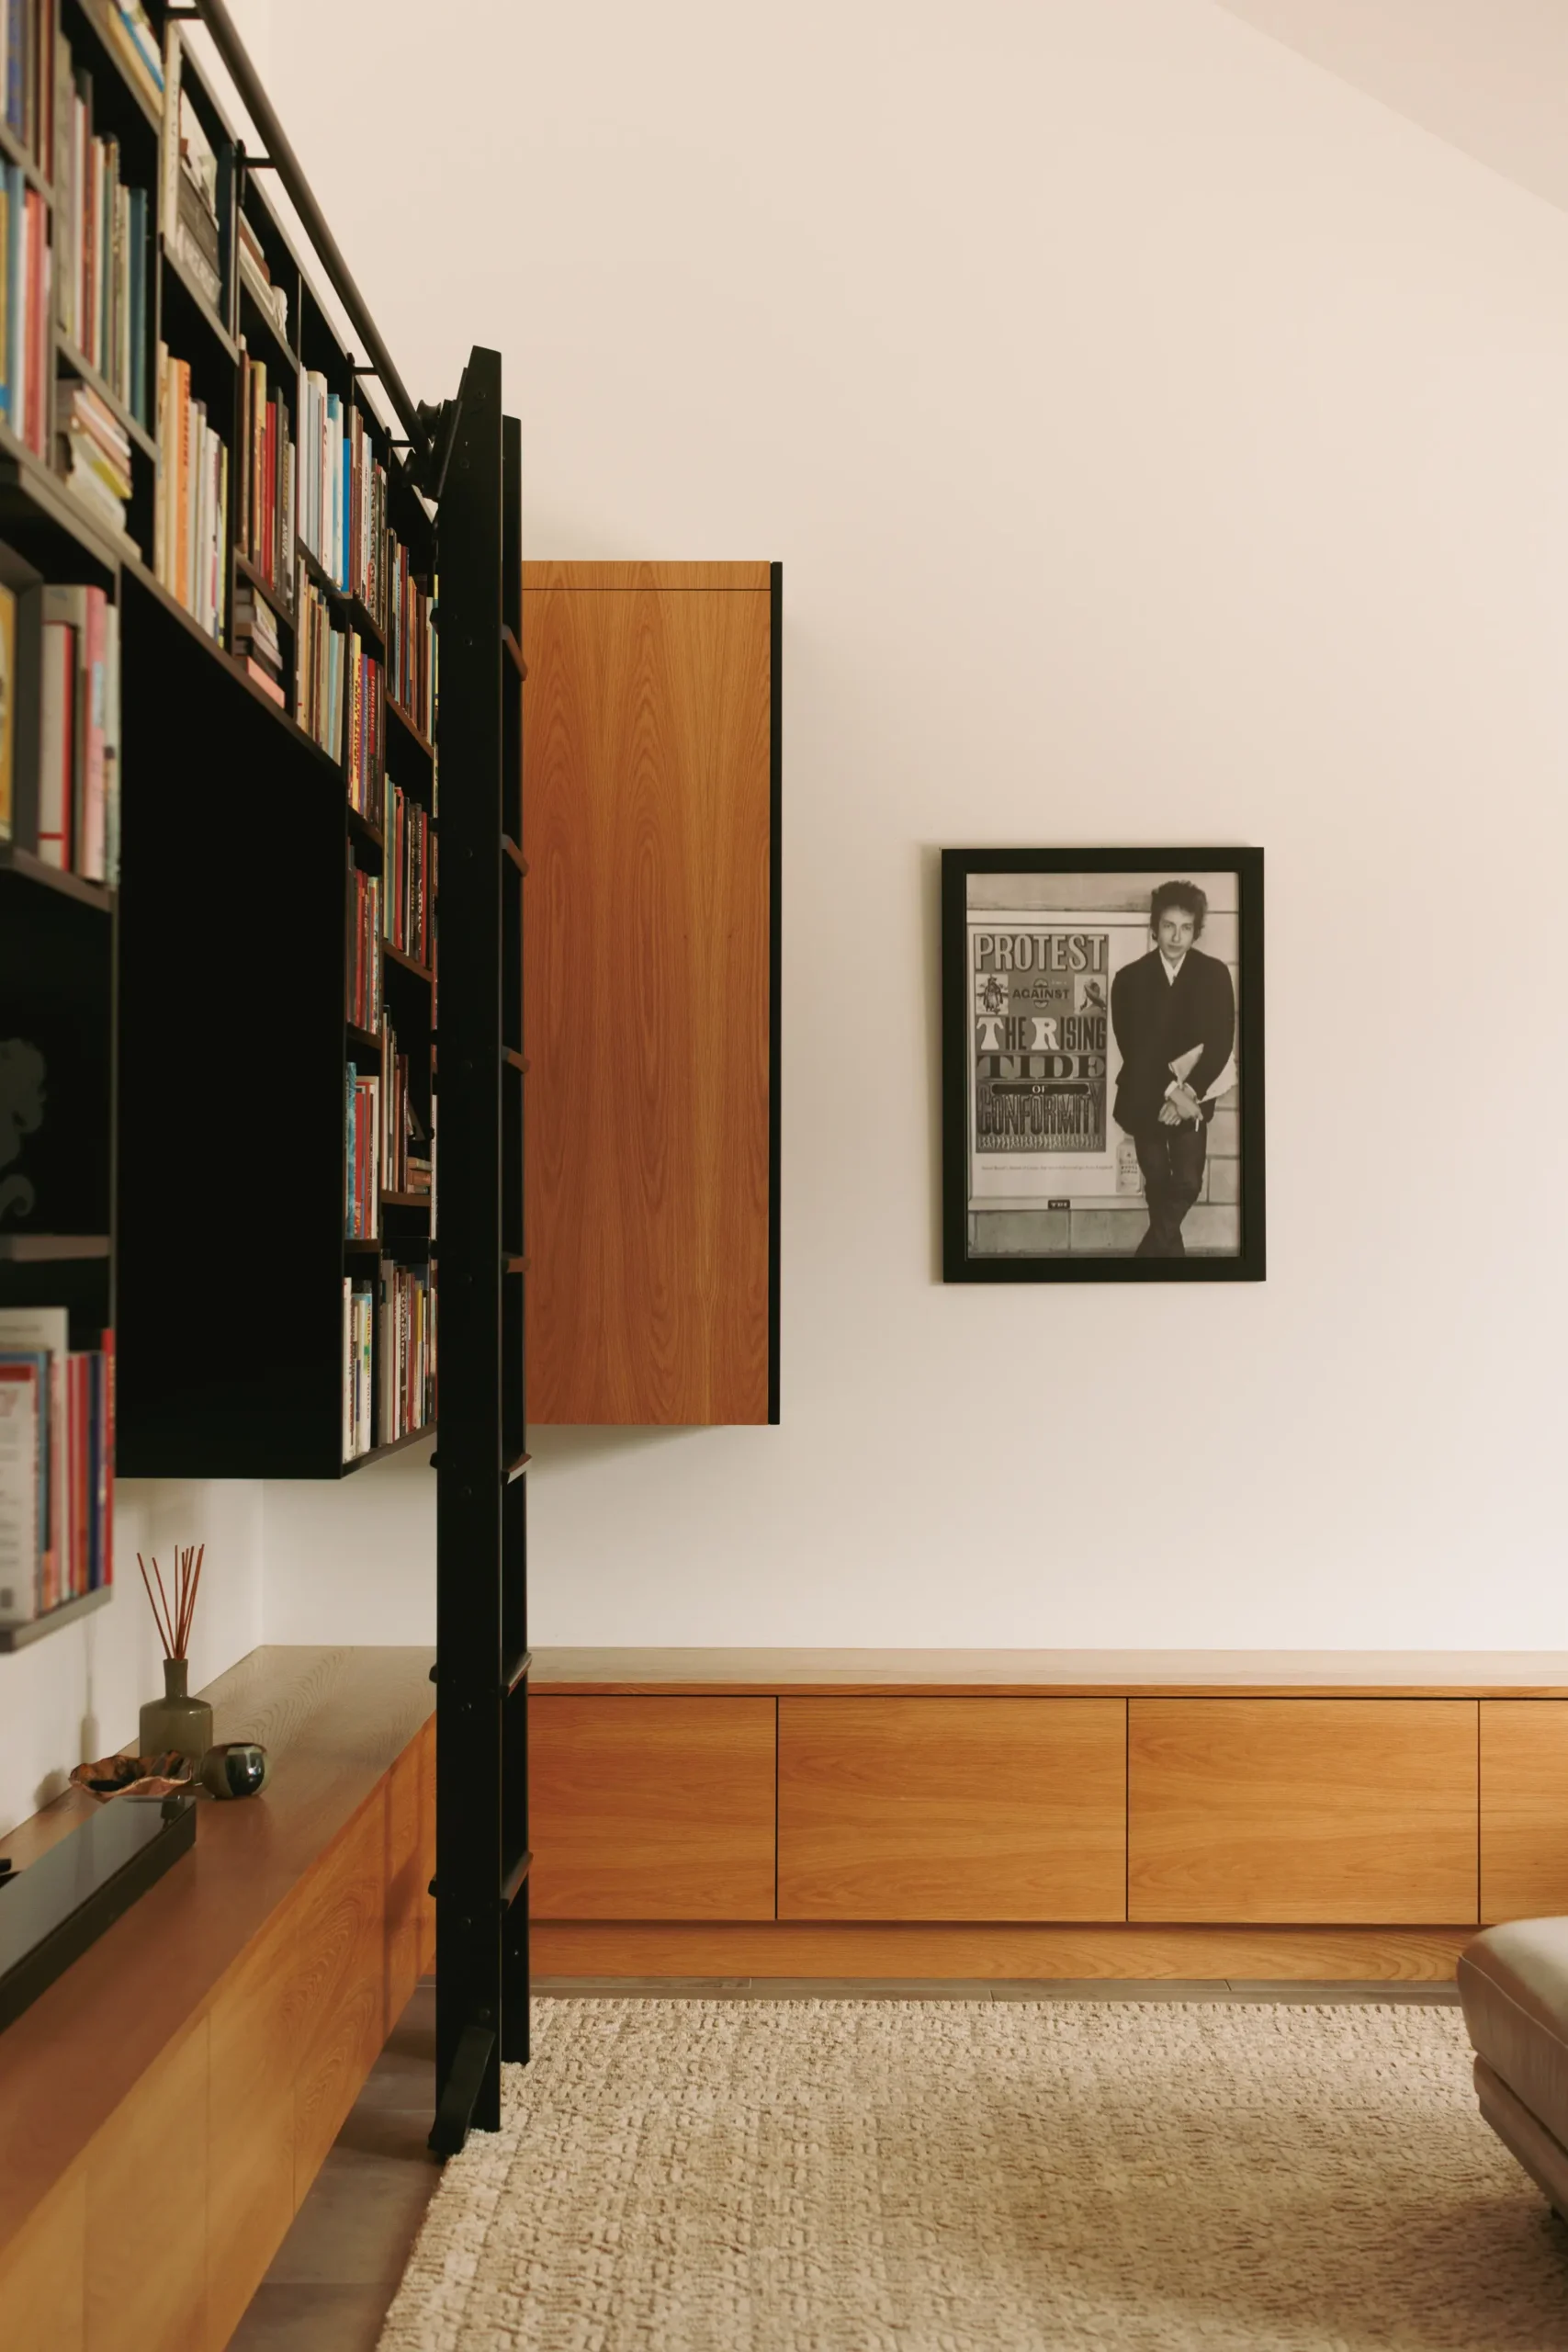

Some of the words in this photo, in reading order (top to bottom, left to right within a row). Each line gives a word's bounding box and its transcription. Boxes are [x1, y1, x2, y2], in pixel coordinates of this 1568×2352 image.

[975, 933, 1106, 972] PROTEST
[1012, 988, 1070, 1000] AGAINST
[976, 1017, 1027, 1051] THE
[1031, 1017, 1107, 1051] RISING
[976, 1055, 1106, 1080] TIDE
[1032, 1084, 1047, 1094] OF
[976, 1083, 1106, 1136] CONFORMITY
